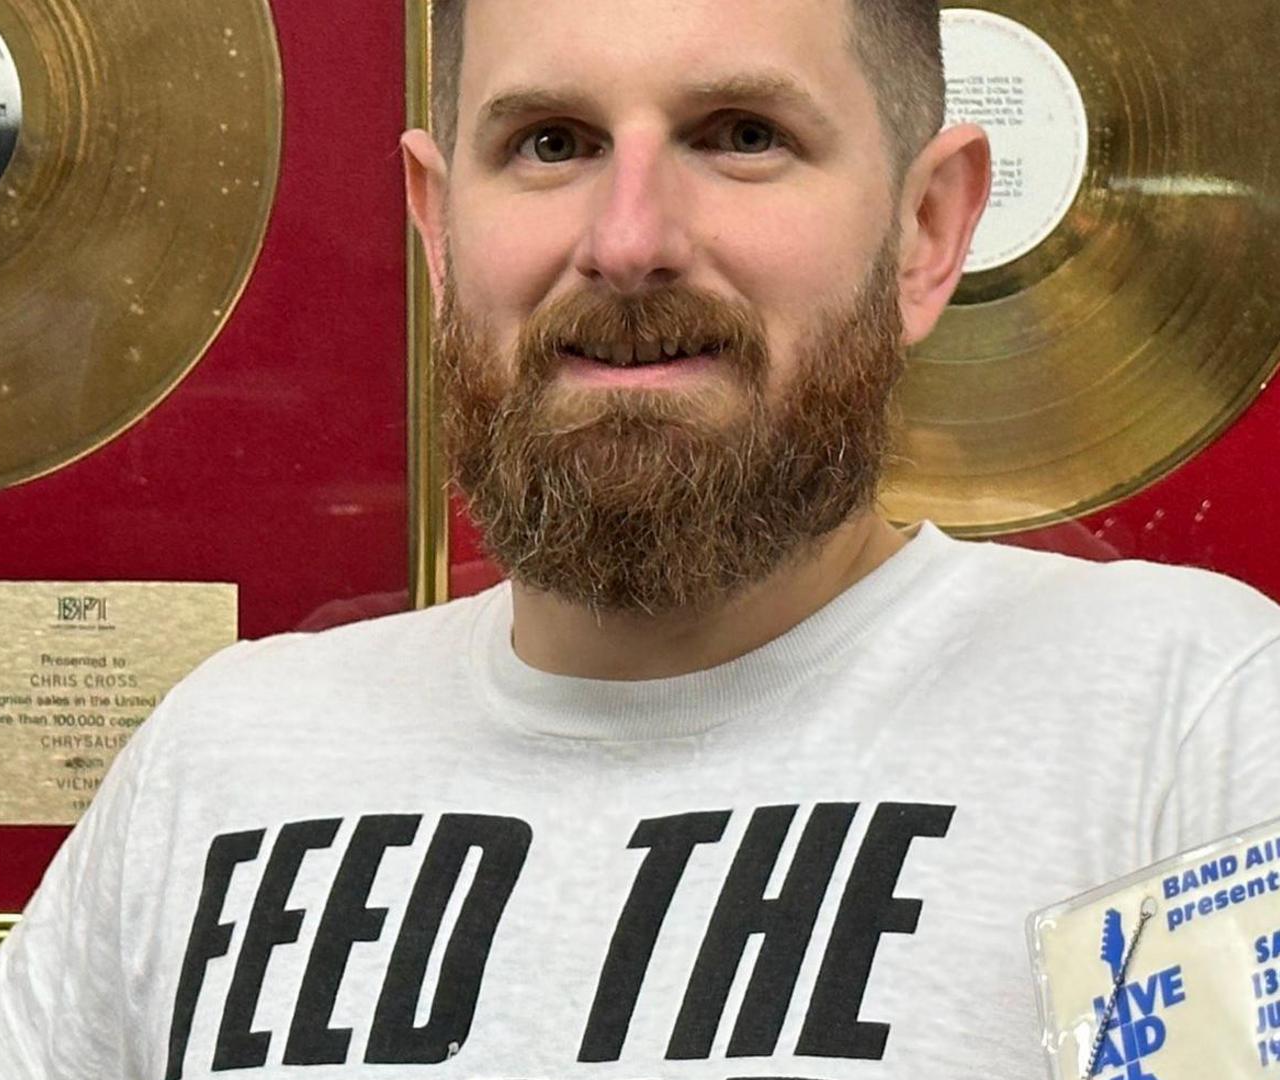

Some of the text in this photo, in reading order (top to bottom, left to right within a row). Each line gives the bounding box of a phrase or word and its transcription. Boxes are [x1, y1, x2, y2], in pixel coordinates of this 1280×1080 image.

[40, 653, 126, 668] Presented to
[30, 673, 138, 689] CHRIS CROSS
[90, 693, 110, 706] the
[115, 693, 156, 708] United
[19, 713, 47, 725] than
[109, 715, 144, 728] copi
[1163, 855, 1238, 900] BAND
[577, 801, 957, 1063] THE
[1090, 1015, 1167, 1077] AID
